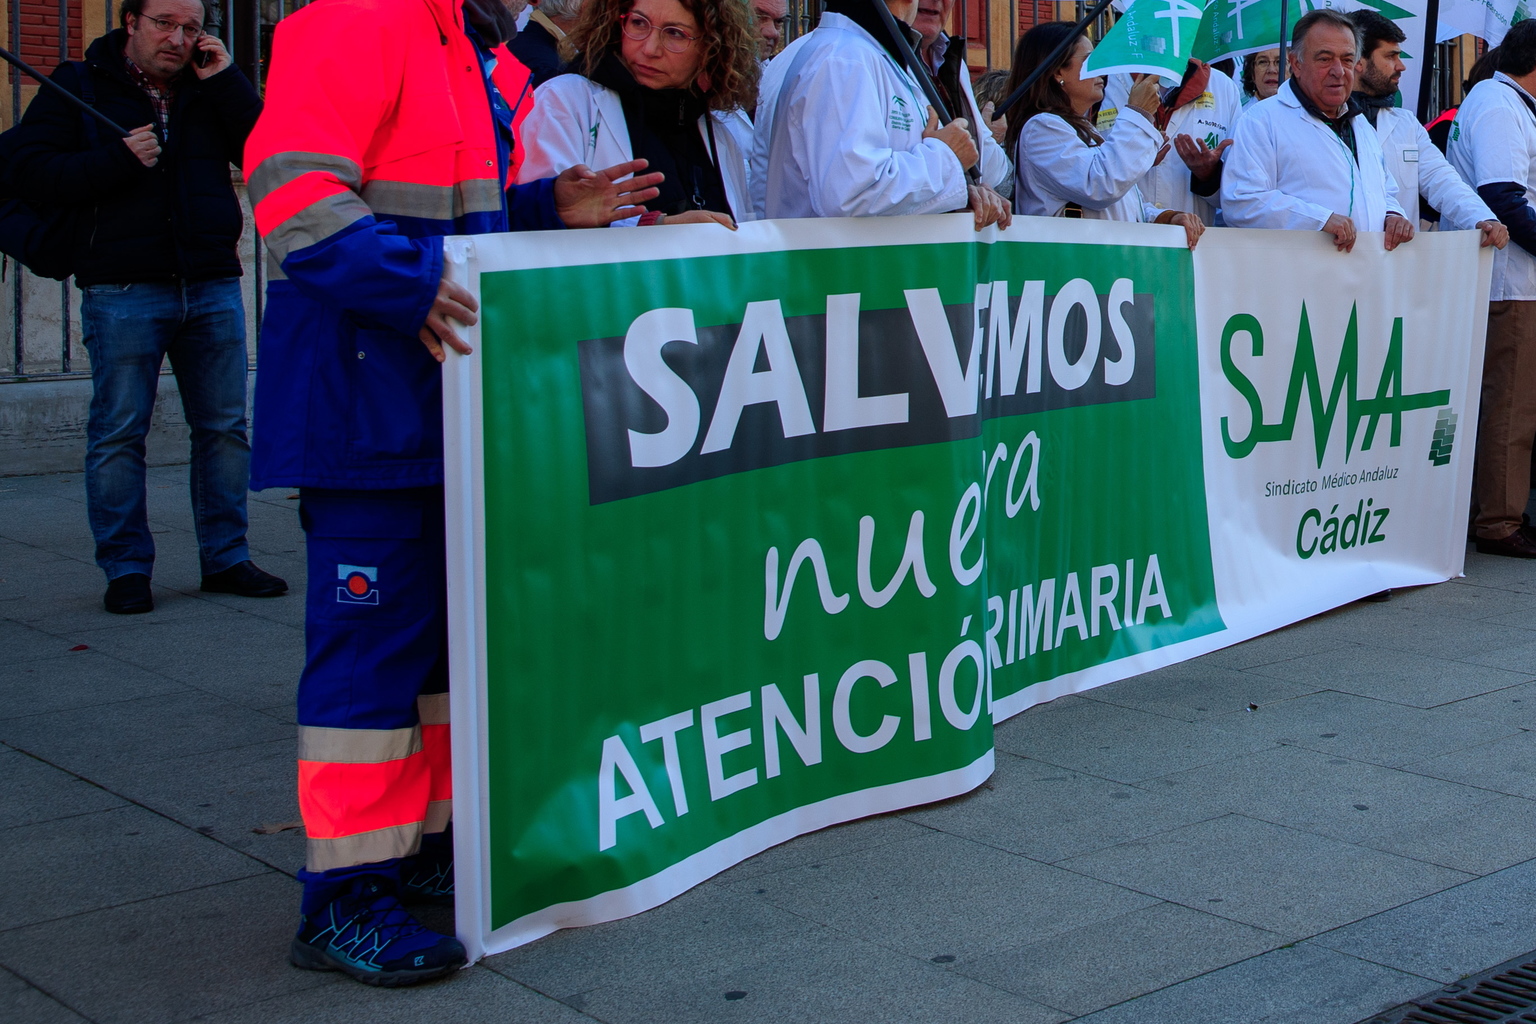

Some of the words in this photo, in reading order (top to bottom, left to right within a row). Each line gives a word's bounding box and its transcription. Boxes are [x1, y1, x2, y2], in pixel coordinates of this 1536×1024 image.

[1219, 298, 1451, 470] SMA
[1264, 478, 1318, 499] Sindicato
[1321, 469, 1358, 491] Médico
[1358, 465, 1399, 485] Andaluz
[1295, 497, 1391, 560] Cádiz
[986, 552, 1173, 670] RIMARIA
